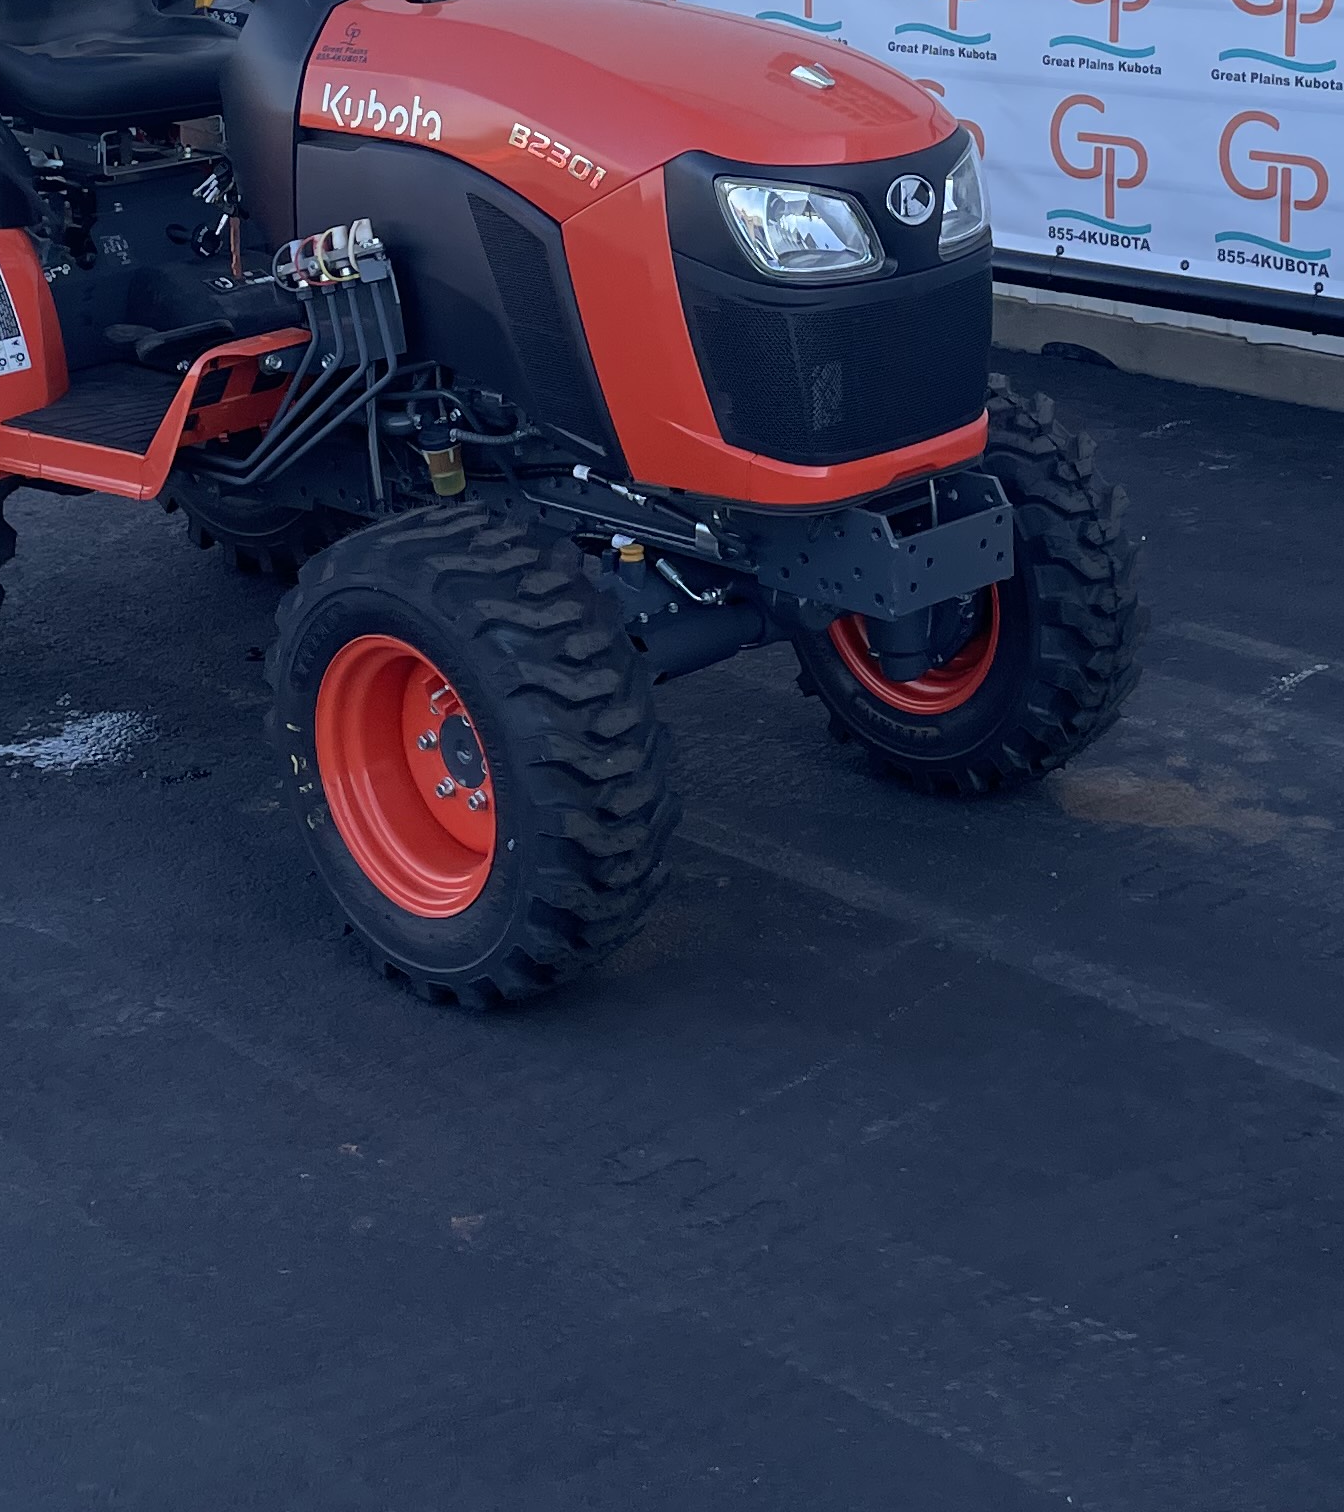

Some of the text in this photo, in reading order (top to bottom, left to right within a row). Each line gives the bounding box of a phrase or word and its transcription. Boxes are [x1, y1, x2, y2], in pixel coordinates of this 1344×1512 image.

[887, 41, 998, 61] Great Plains Kubota
[1042, 54, 1162, 76] Great Plains Kubota
[1210, 68, 1344, 91] Great Plains Kubota
[320, 82, 443, 141] Kubota
[508, 122, 607, 189] B2301
[1050, 94, 1148, 218] GP
[1219, 111, 1329, 243] GP
[1048, 225, 1152, 252] 855-4KUBOTA
[1216, 248, 1330, 279] 855-4KUBOTA
